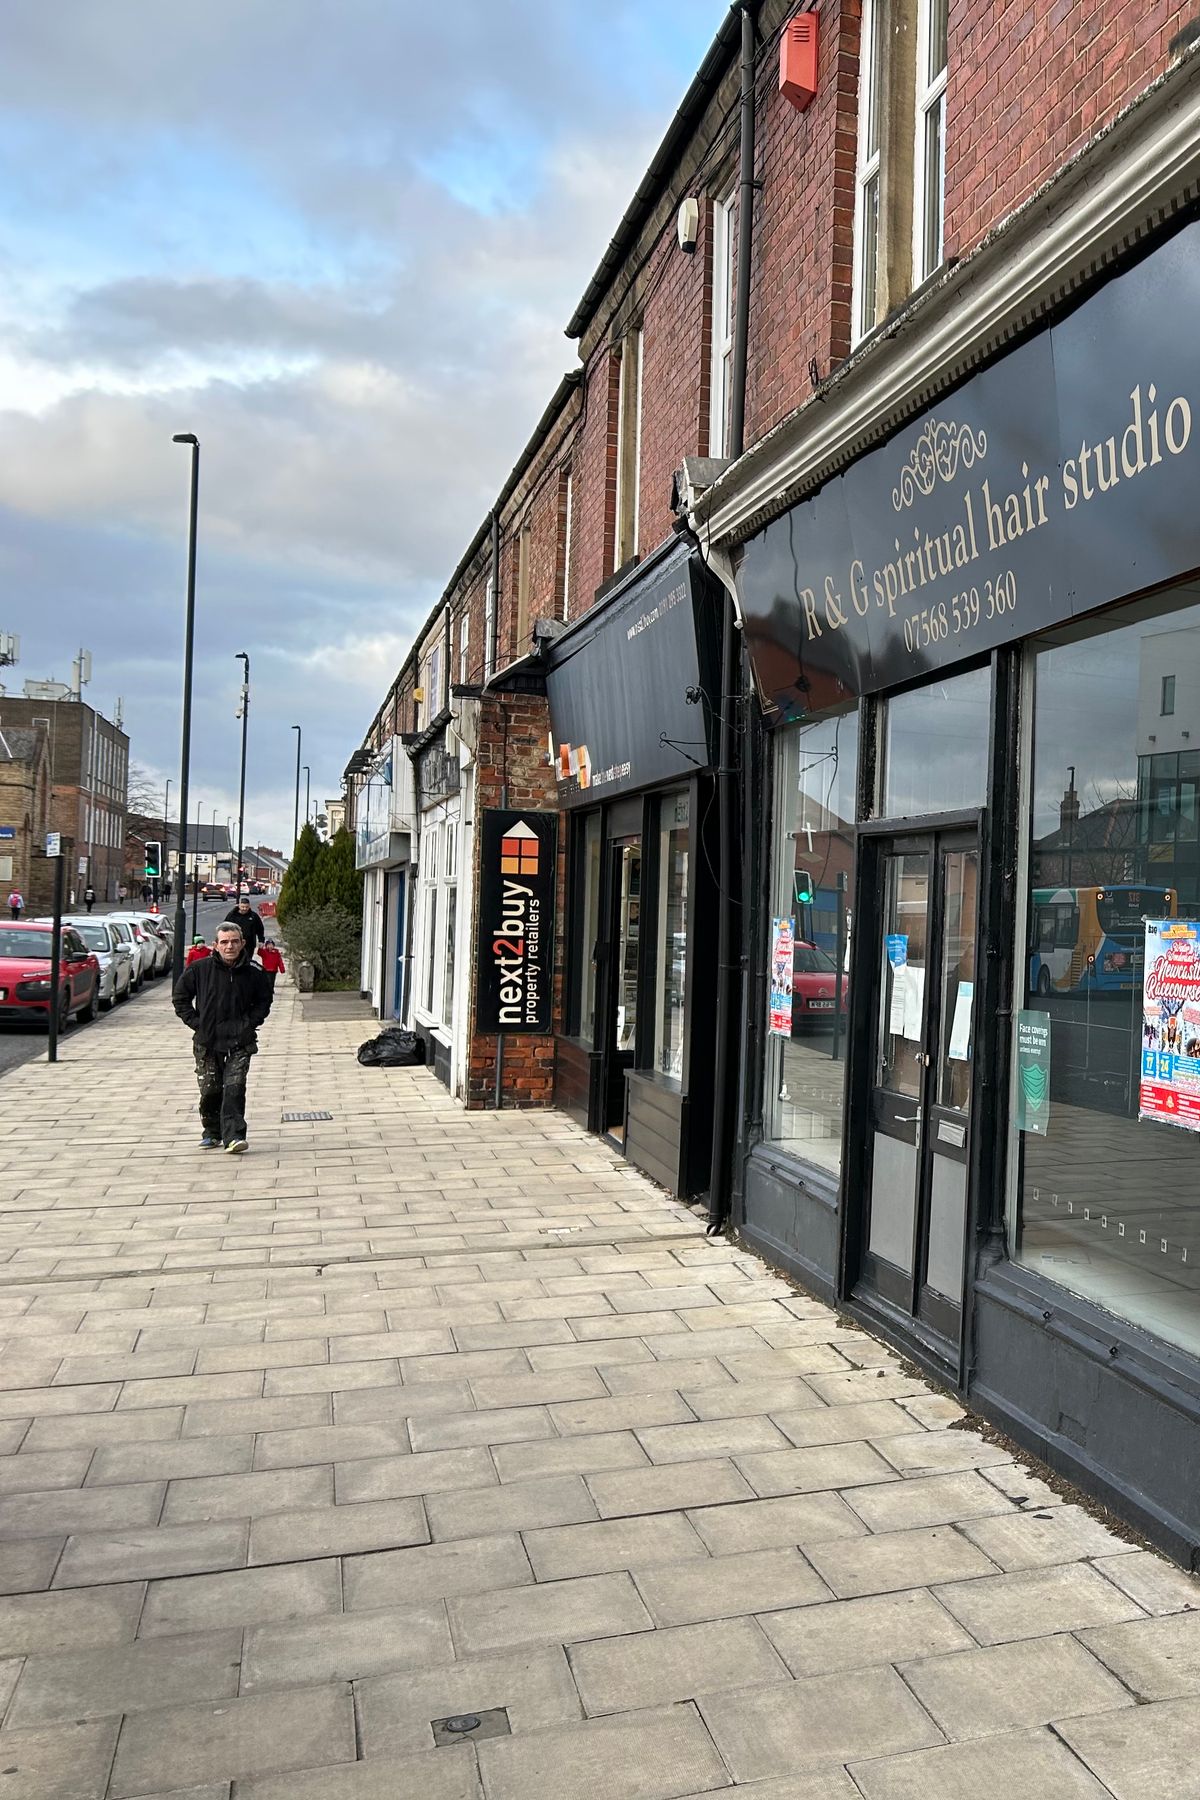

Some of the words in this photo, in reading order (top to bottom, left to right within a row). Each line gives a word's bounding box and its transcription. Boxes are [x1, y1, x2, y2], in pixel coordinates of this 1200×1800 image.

[801, 588, 823, 641] R
[824, 576, 849, 631] &
[849, 559, 870, 616] G
[873, 497, 979, 617] spiritual
[982, 461, 1052, 551] hair
[1063, 383, 1192, 510] studio
[903, 603, 949, 654] 07568
[951, 593, 982, 639] 539
[984, 570, 1018, 628] 360
[492, 879, 534, 1024] next2buy
[525, 899, 540, 959] retailers
[525, 963, 541, 1024] property
[1019, 1023, 1031, 1034] Face
